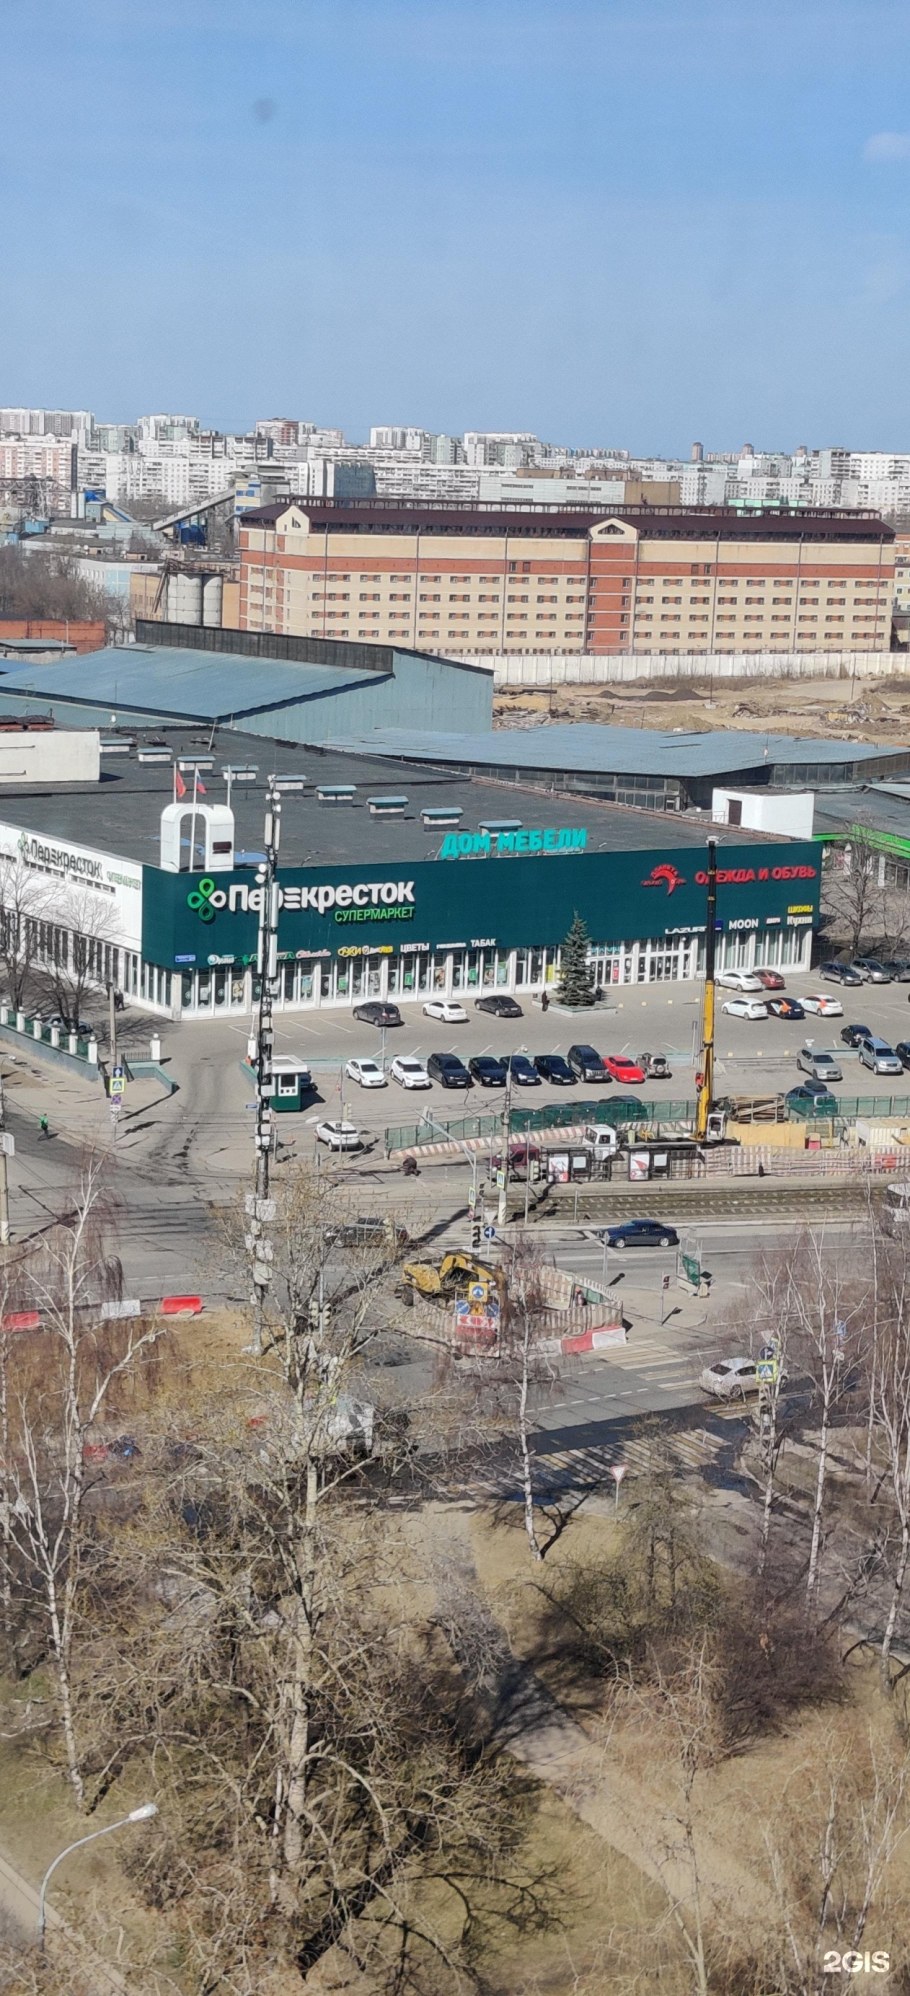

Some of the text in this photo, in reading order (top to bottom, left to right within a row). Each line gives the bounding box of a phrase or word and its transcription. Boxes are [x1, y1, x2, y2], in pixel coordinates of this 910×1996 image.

[440, 828, 588, 860] ДОМ МЕБЕЛИ
[758, 867, 770, 881] И
[771, 865, 817, 880] ОБУВЬ
[334, 906, 415, 922] СУПЕРМАРКЕТ
[728, 918, 759, 930] MOON
[400, 943, 430, 953] ЦВЕТЫ
[470, 938, 497, 948] ТАБАК
